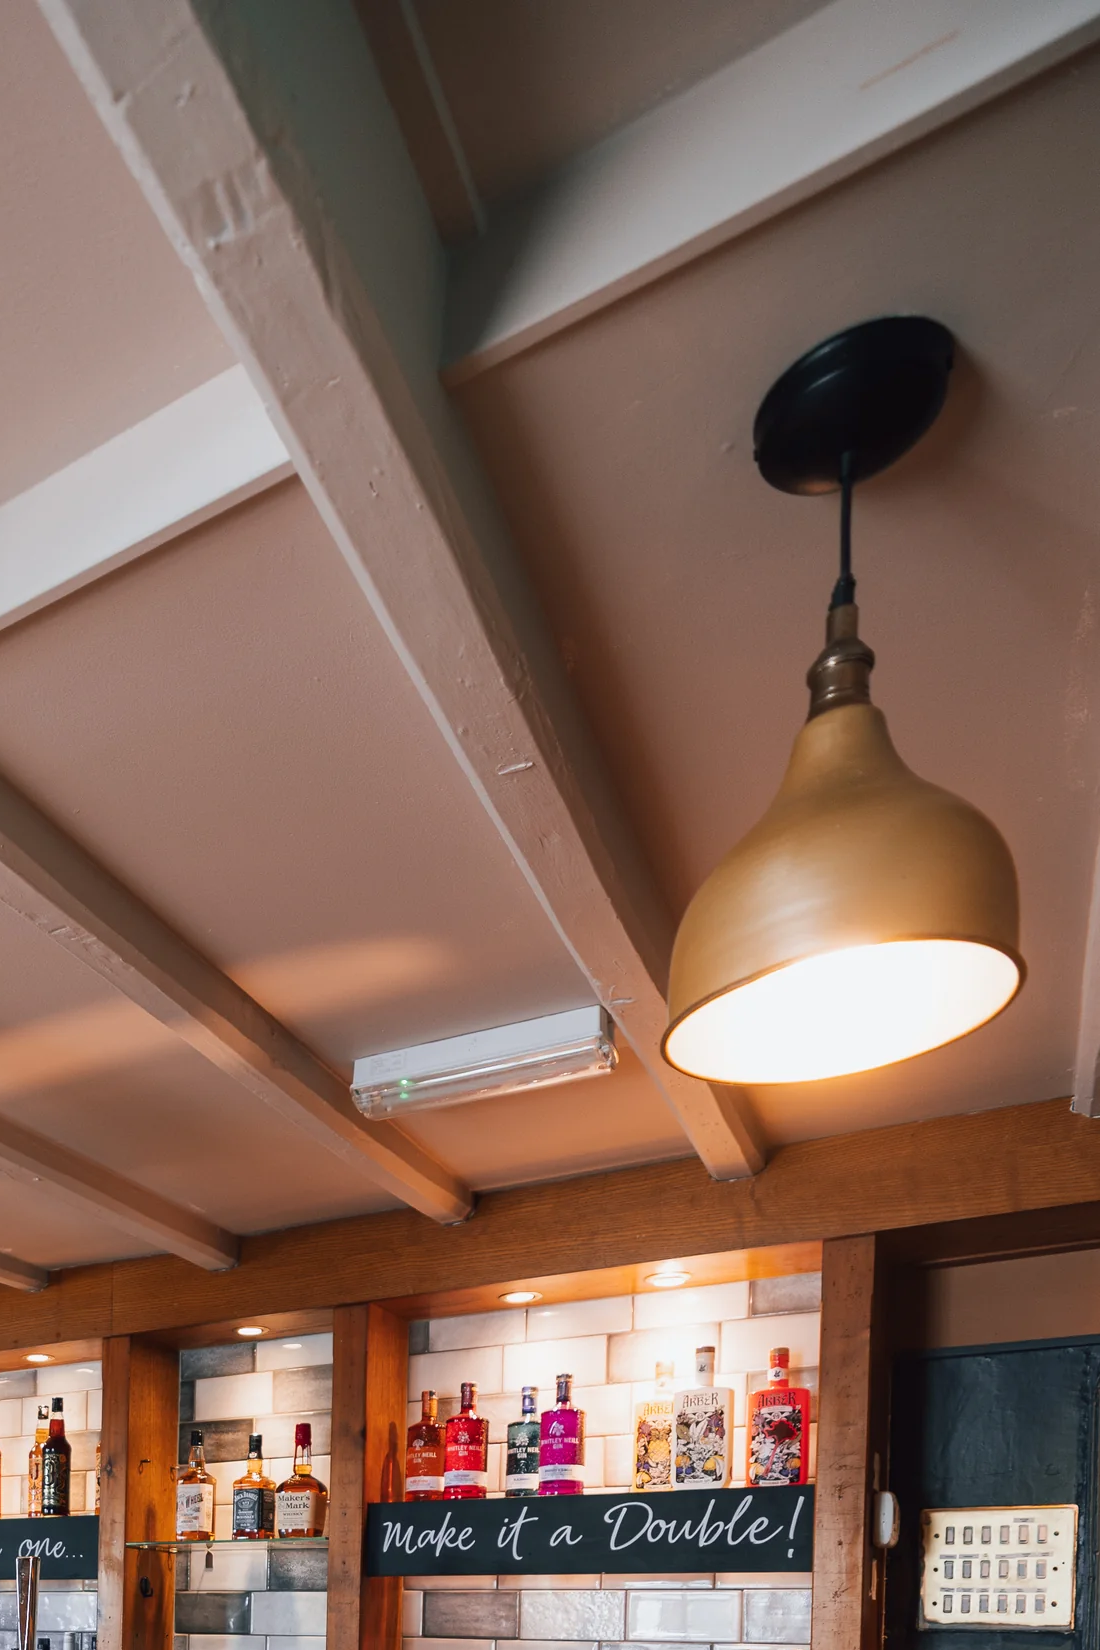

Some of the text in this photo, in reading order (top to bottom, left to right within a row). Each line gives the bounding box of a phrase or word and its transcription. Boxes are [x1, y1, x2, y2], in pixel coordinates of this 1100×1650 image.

[682, 1391, 719, 1408] ARBER
[757, 1391, 797, 1408] ARBER
[278, 1494, 311, 1502] Maker's
[382, 1511, 476, 1558] Make
[496, 1505, 539, 1561] it
[549, 1524, 584, 1548] a
